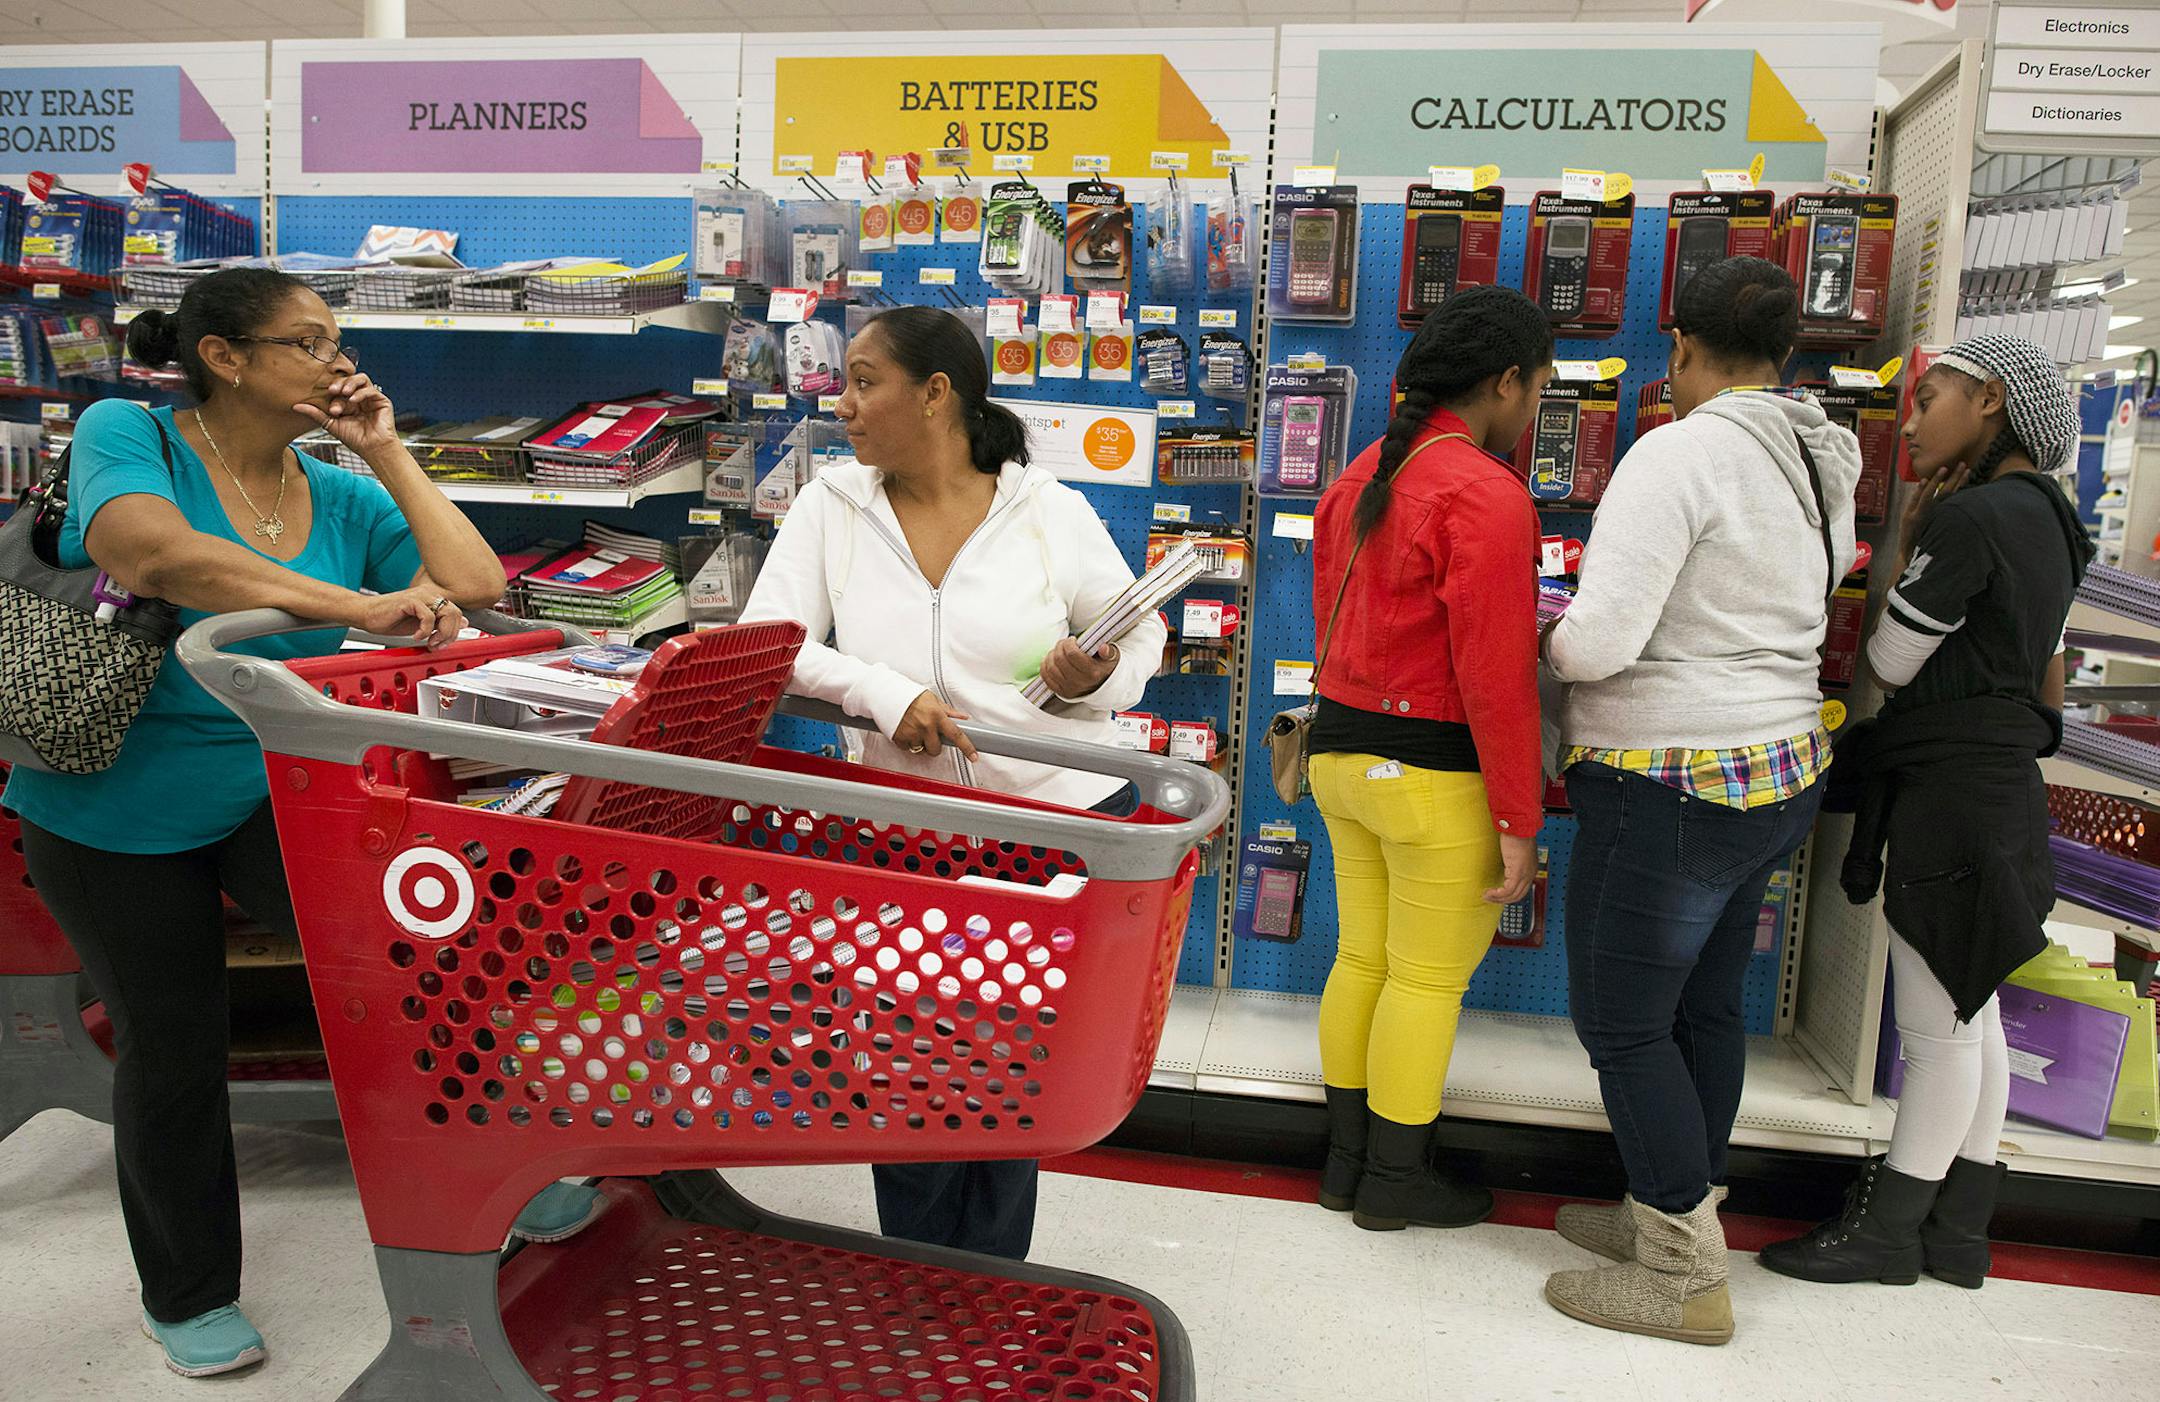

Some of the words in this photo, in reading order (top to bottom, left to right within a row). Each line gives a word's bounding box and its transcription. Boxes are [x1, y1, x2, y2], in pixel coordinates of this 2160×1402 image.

[2045, 19, 2130, 35] Electronics
[2018, 62, 2045, 79] Dry
[2049, 63, 2152, 79] Erase/Locker
[900, 80, 1098, 112] BATTERIES
[40, 89, 134, 117] ERASE
[408, 101, 588, 131] PLANNERS
[1410, 97, 1727, 133] CALCULATORS
[2032, 106, 2122, 121] Dictionaries
[0, 125, 116, 153] BOARDS
[980, 121, 1050, 153] USB
[992, 188, 1039, 201] Energizer
[1074, 192, 1118, 206] Energizer
[1276, 193, 1315, 203] CASIO
[1411, 189, 1436, 199] Texas
[1410, 198, 1464, 207] Instruments
[1539, 196, 1564, 206] Texas
[1674, 198, 1700, 207] Texas
[1798, 197, 1824, 207] Texas
[1538, 204, 1593, 214] Instruments
[1672, 205, 1730, 215] Instruments
[1796, 205, 1854, 216] Instruments
[1140, 337, 1178, 349] Energizer
[1202, 339, 1242, 351] Energizer
[1267, 376, 1310, 387] CASIO
[1806, 387, 1827, 396] exas
[1191, 431, 1221, 442] Energizer
[783, 458, 794, 471] 16
[1539, 482, 1565, 492] Inside!
[709, 487, 748, 500] SanDisk
[1182, 529, 1213, 539] Energizer
[715, 551, 727, 562] 16
[1564, 546, 1581, 559] sale
[692, 594, 729, 605] SanDisk
[1185, 609, 1201, 617] 7.49
[1222, 611, 1237, 624] sale
[1172, 731, 1187, 739] 7.49
[1247, 843, 1284, 856] CASIO
